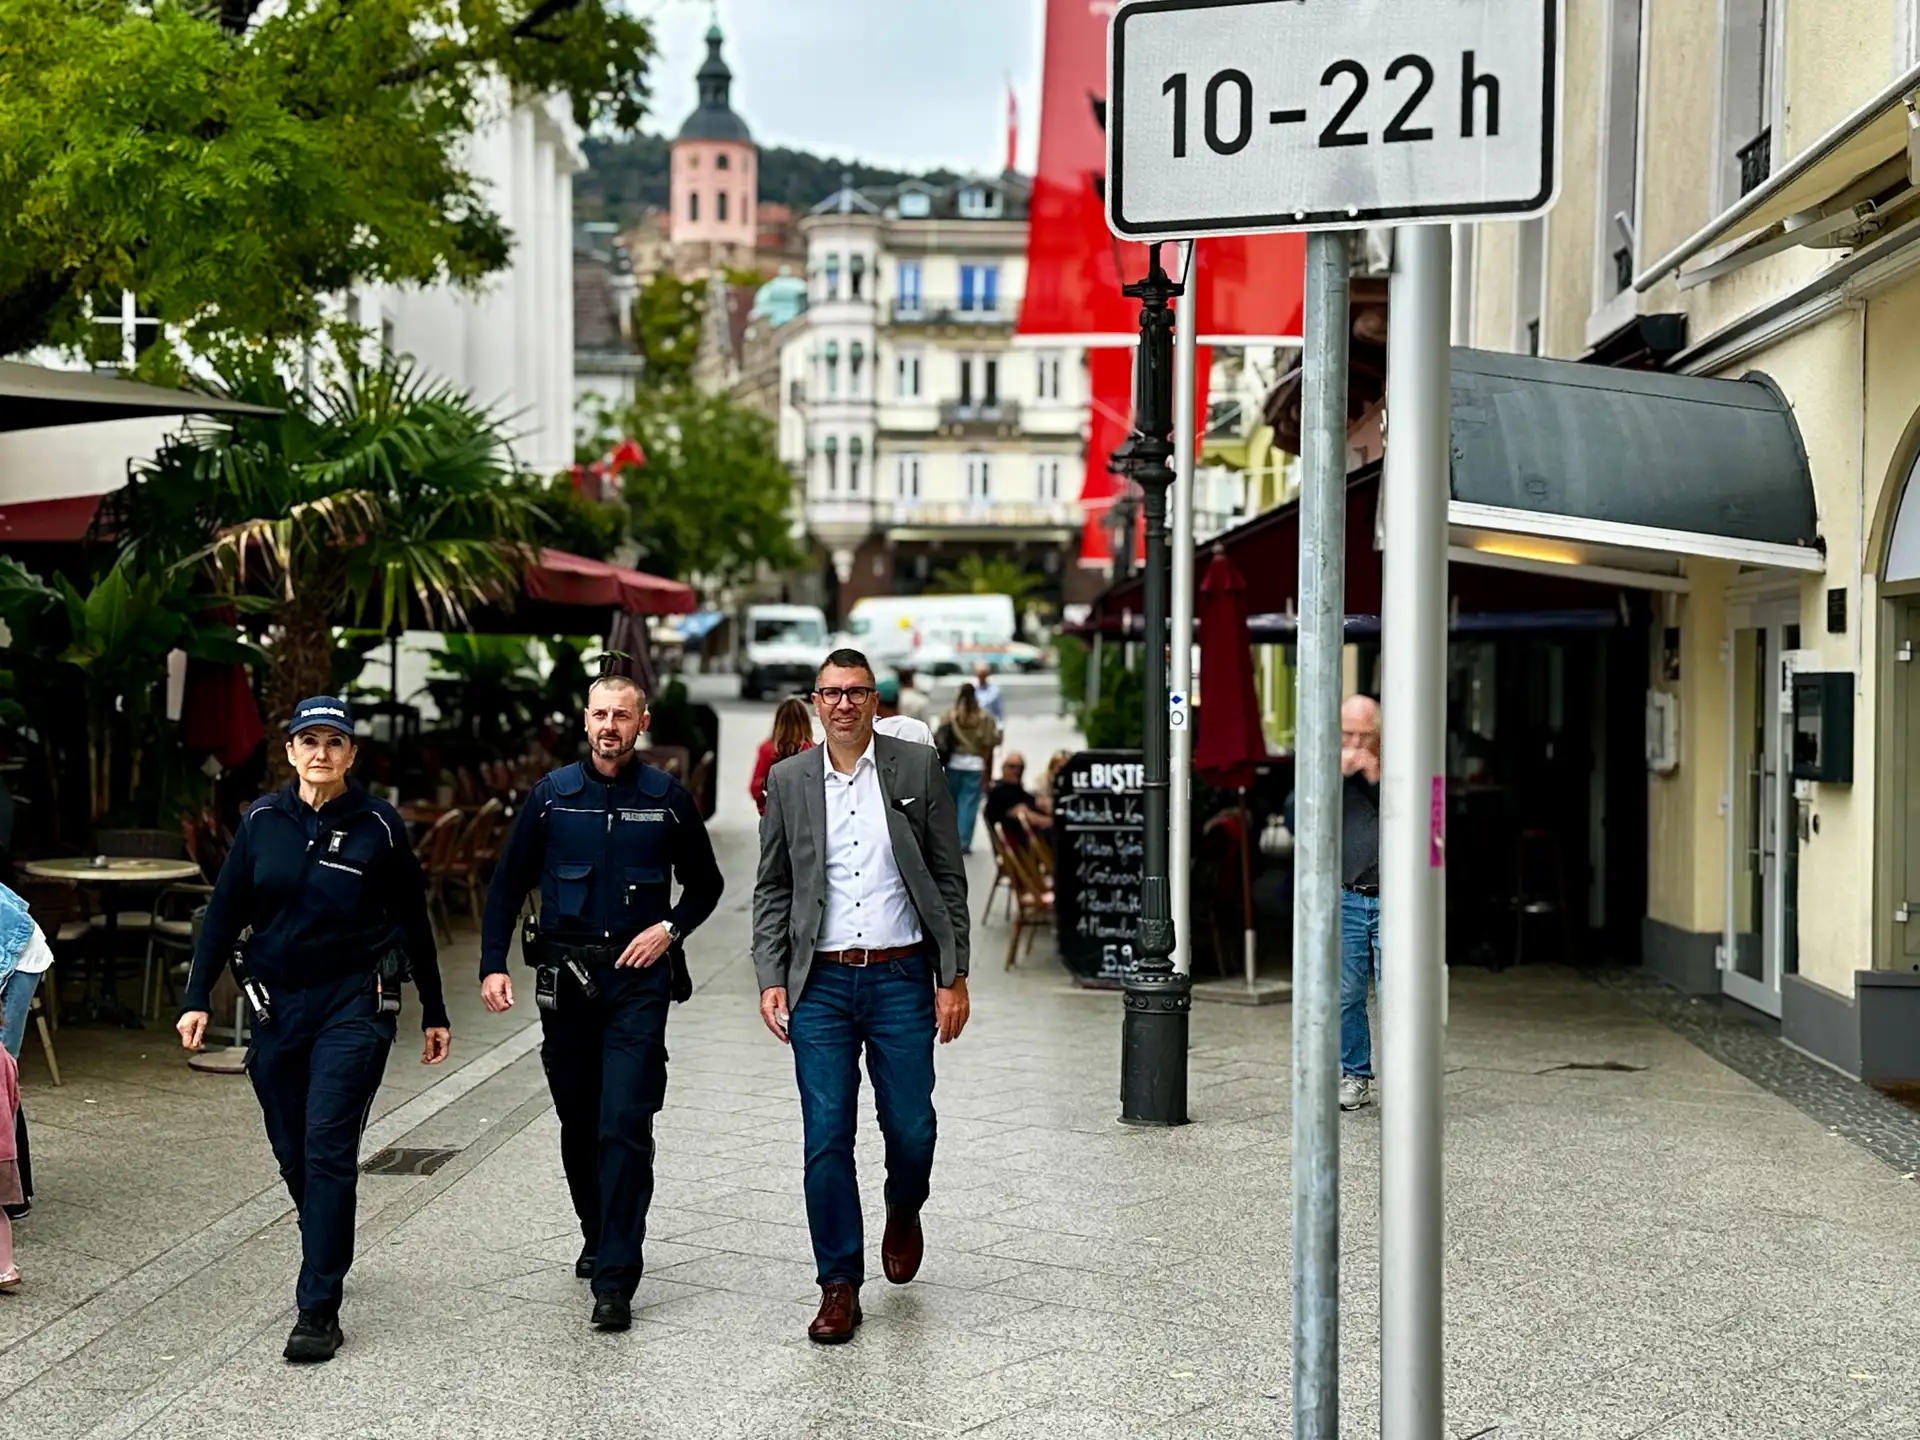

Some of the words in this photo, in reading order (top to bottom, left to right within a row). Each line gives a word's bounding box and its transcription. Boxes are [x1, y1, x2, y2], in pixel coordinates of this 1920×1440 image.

[1162, 54, 1434, 158] 10-22
[1460, 50, 1501, 138] h
[1072, 771, 1089, 788] LE
